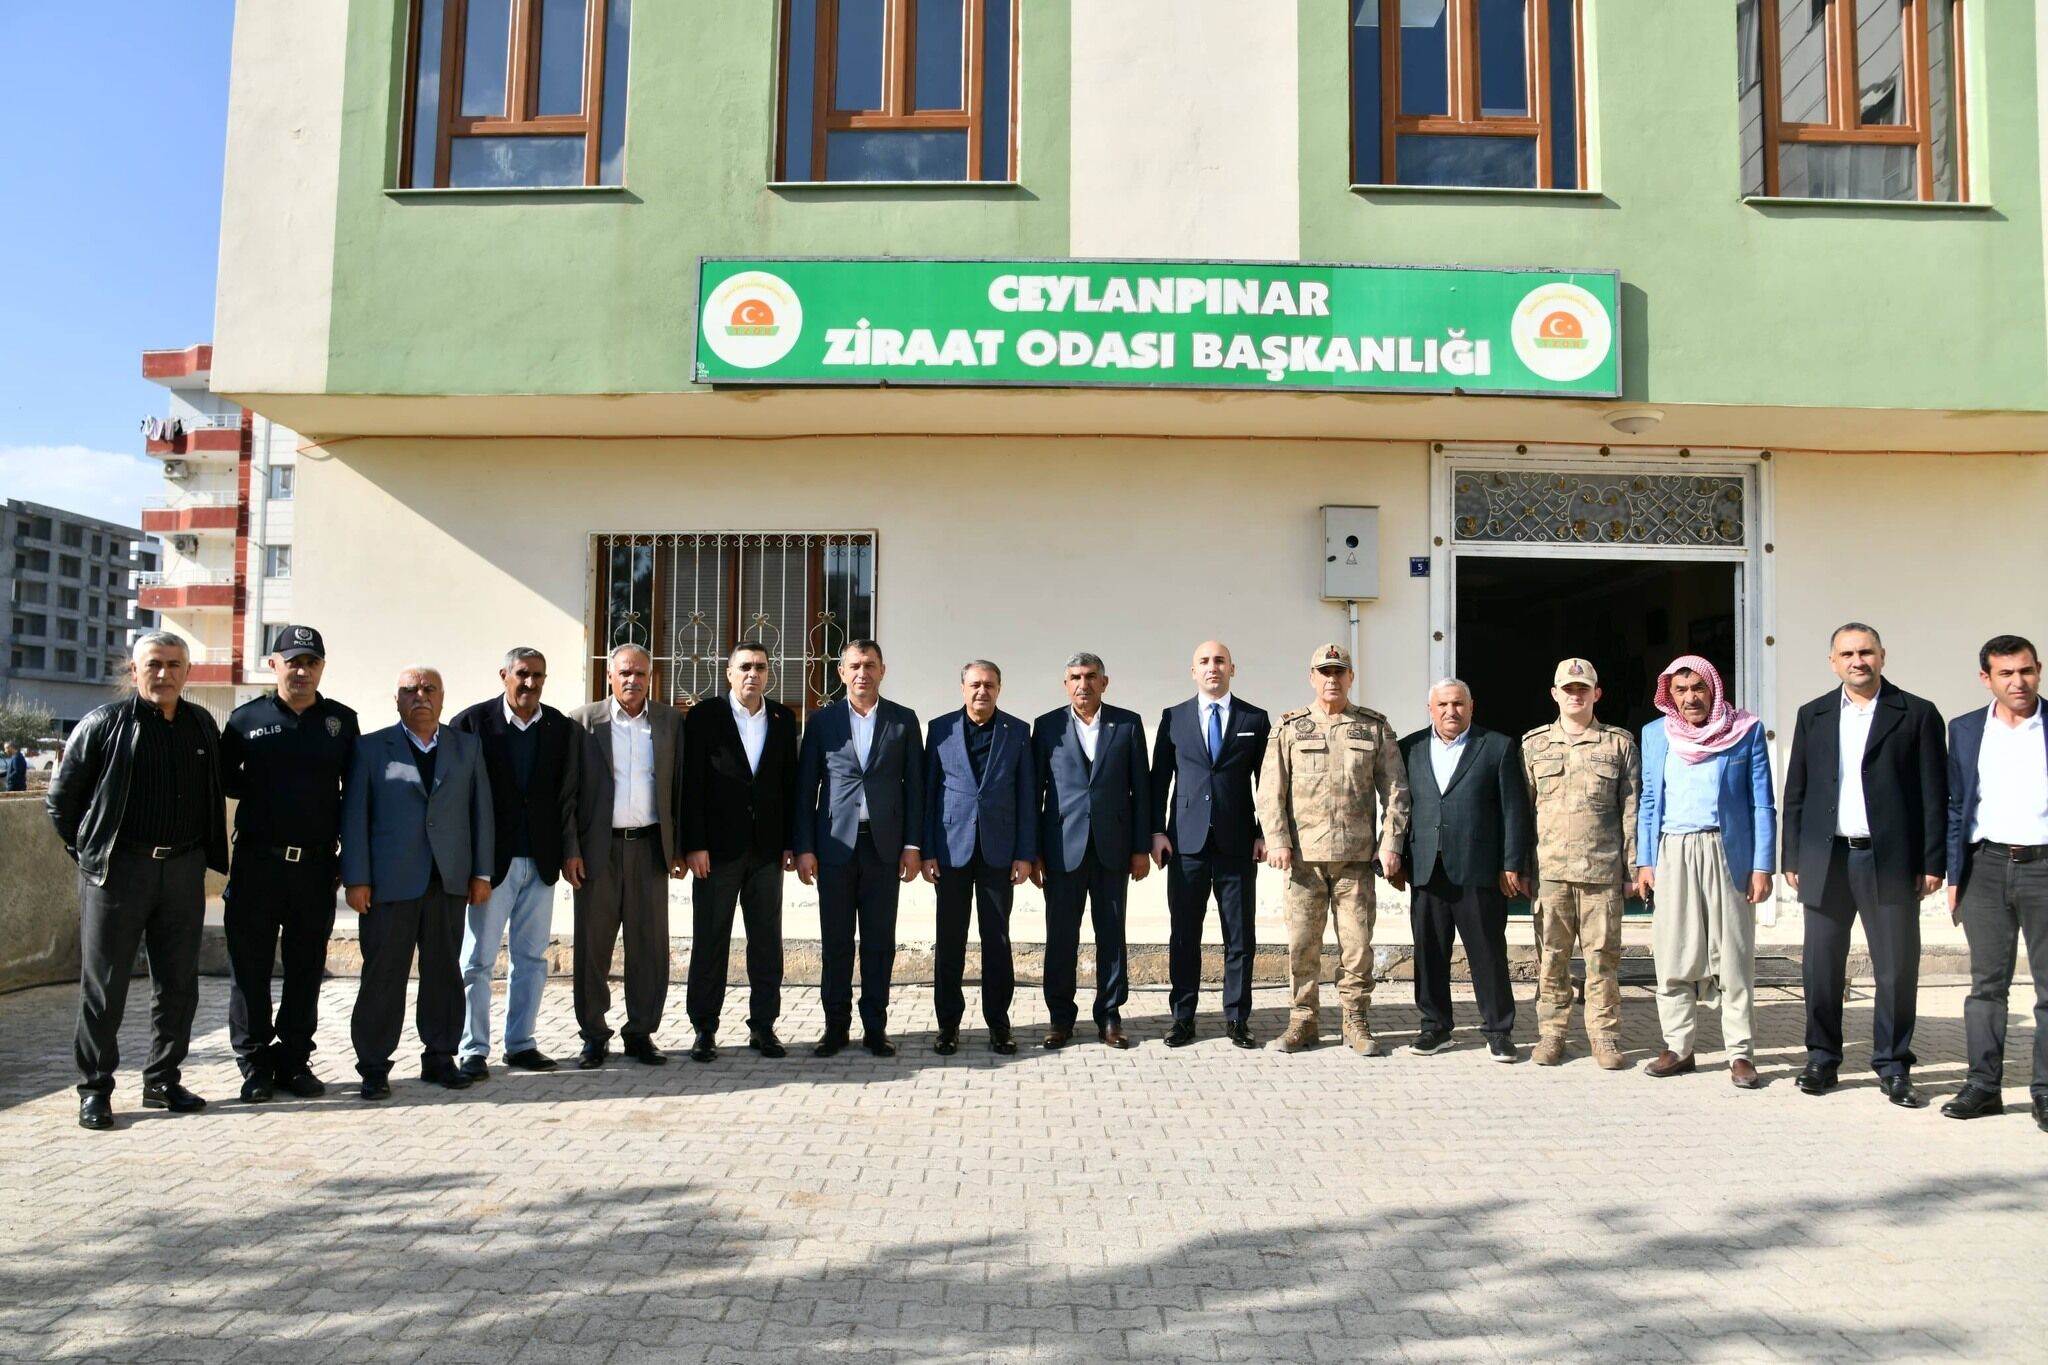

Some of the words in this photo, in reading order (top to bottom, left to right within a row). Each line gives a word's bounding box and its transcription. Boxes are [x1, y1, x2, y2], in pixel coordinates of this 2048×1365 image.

[988, 274, 1329, 315] CEYLANPINAR
[822, 317, 1005, 366] ZİRAAT
[1016, 329, 1175, 368] ODASI
[1192, 328, 1492, 382] BAŞKANLIĞI
